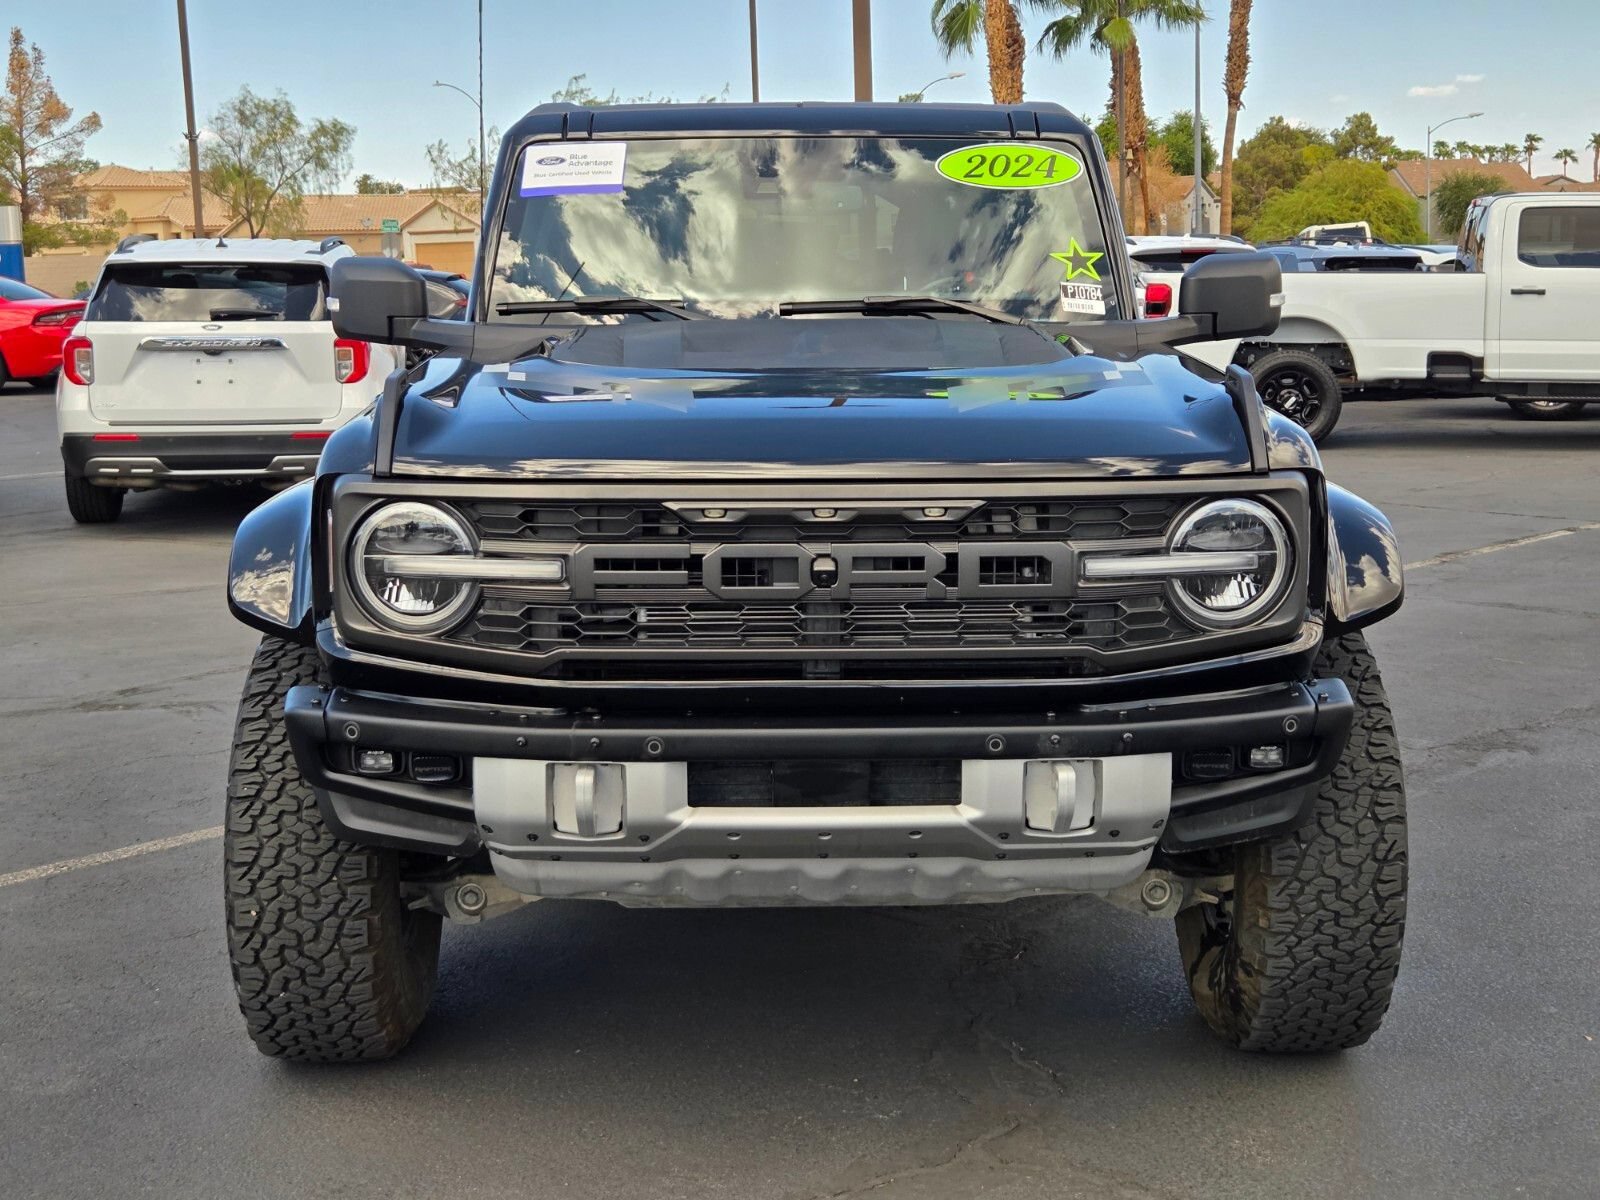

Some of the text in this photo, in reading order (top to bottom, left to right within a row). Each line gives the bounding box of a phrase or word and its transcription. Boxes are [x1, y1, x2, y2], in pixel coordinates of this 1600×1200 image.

[539, 156, 564, 166] Ford
[568, 159, 614, 168] Advantage
[963, 154, 1059, 178] 2024
[1067, 285, 1103, 301] P10784
[162, 339, 262, 347] EXPLORER
[575, 541, 1076, 601] FORD
